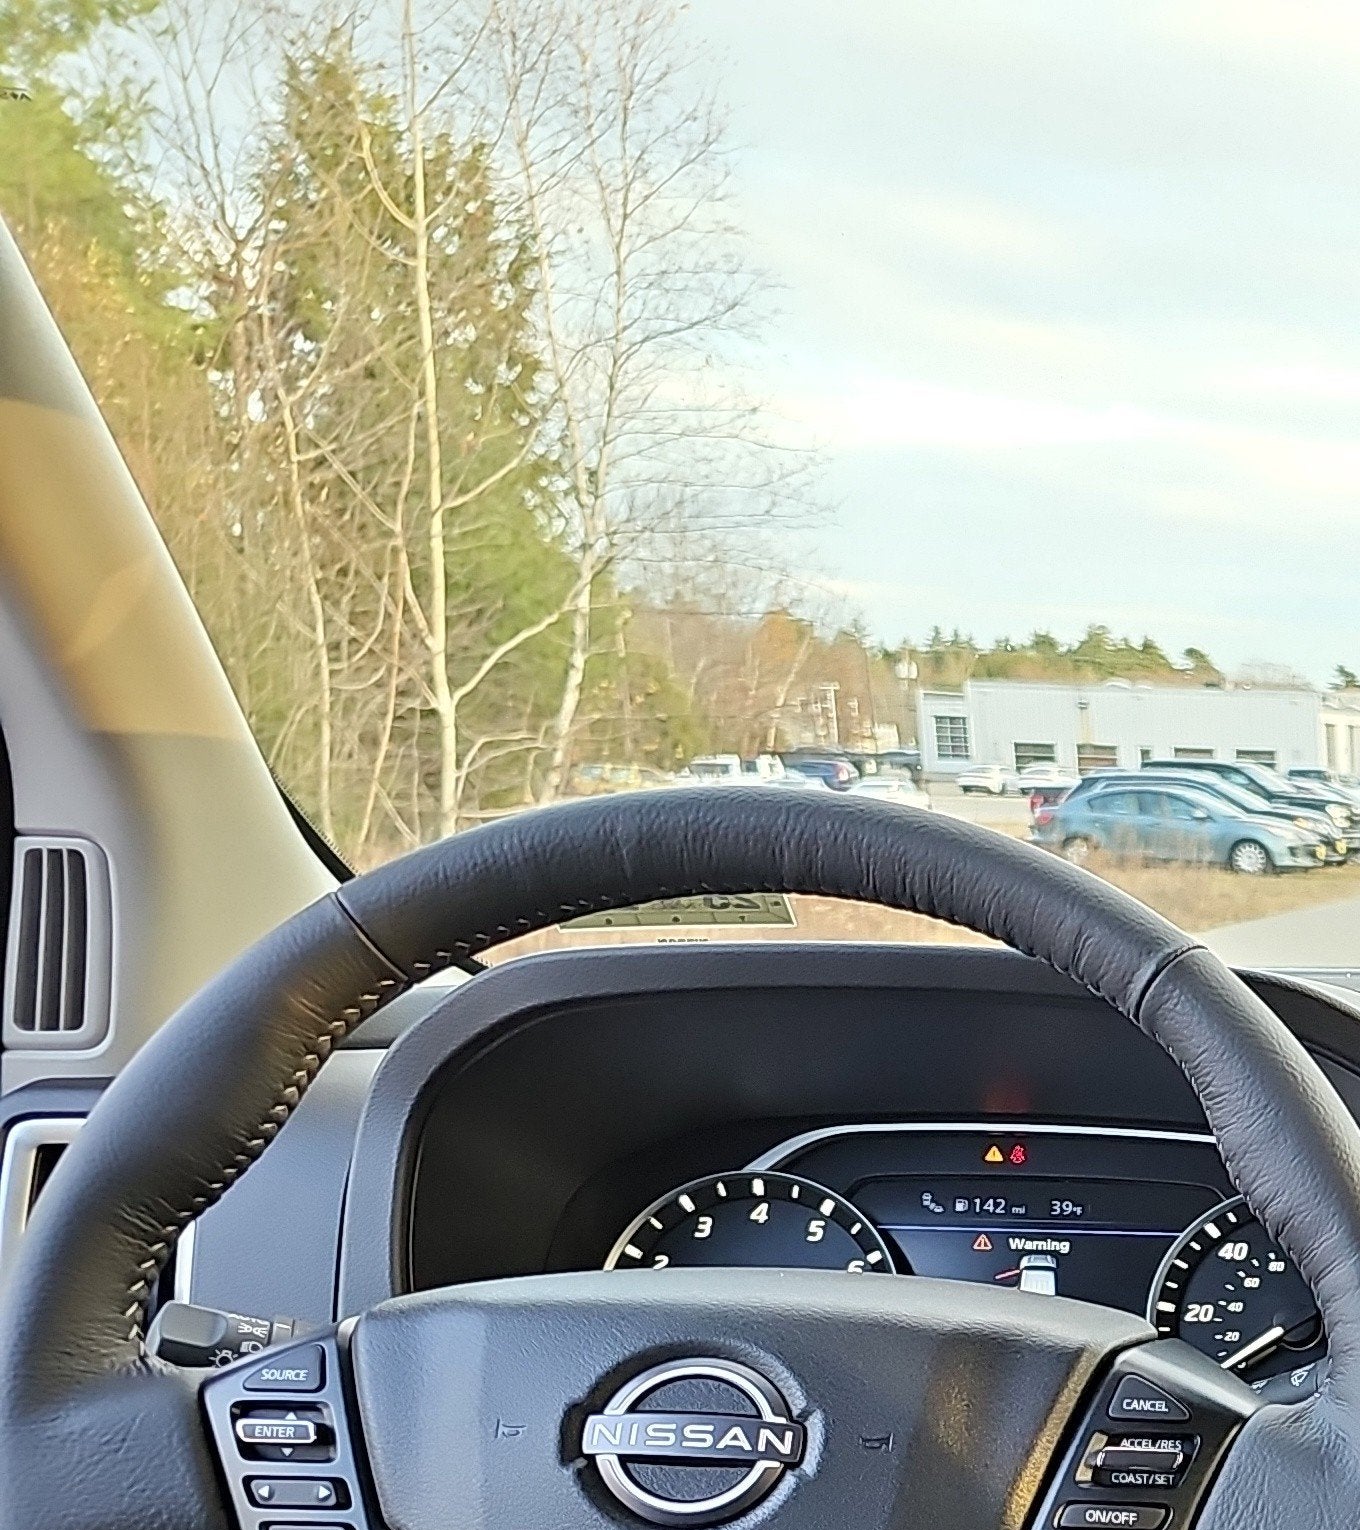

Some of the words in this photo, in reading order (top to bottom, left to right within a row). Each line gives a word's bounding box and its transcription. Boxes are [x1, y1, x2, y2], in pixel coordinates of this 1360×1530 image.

[750, 1202, 769, 1224] 4
[973, 1198, 1006, 1214] 142
[694, 1216, 713, 1238] 3
[806, 1220, 826, 1242] 5
[1008, 1237, 1071, 1254] Warning
[1218, 1242, 1249, 1261] 40
[1184, 1304, 1214, 1323] 20
[1227, 1302, 1244, 1312] 40
[1223, 1331, 1240, 1342] 20
[260, 1368, 309, 1381] SOURCE
[1122, 1399, 1169, 1412] CANCEL
[254, 1425, 296, 1438] ENTER
[591, 1423, 794, 1455] NISSAN
[1120, 1438, 1182, 1449] ACCEL/RES
[1111, 1472, 1175, 1485] COAST/SET
[1085, 1510, 1138, 1524] ON/OFF
